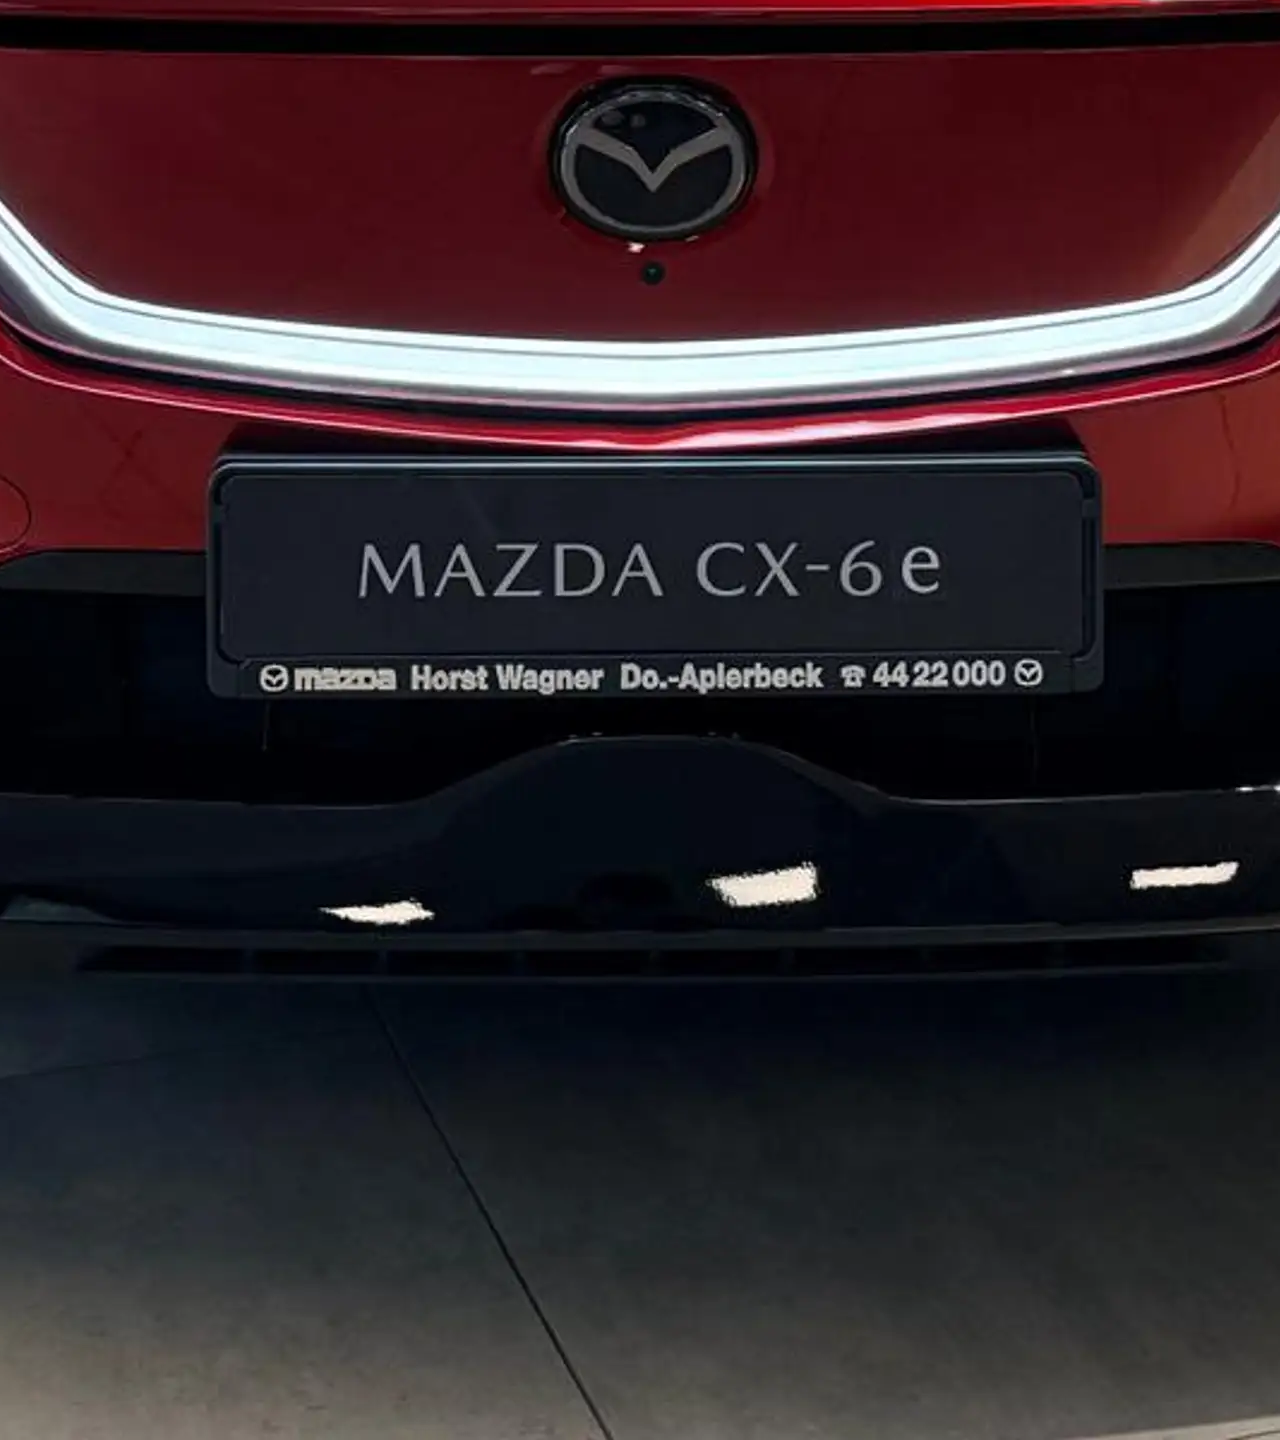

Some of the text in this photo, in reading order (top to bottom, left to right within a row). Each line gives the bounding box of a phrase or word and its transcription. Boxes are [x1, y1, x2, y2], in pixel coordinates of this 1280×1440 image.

[357, 540, 941, 598] MAZDA CX-6e
[293, 667, 398, 692] mazda
[410, 664, 490, 692] Horst
[494, 663, 606, 696] Wagner
[619, 661, 825, 696] Do.-Aplerbeck
